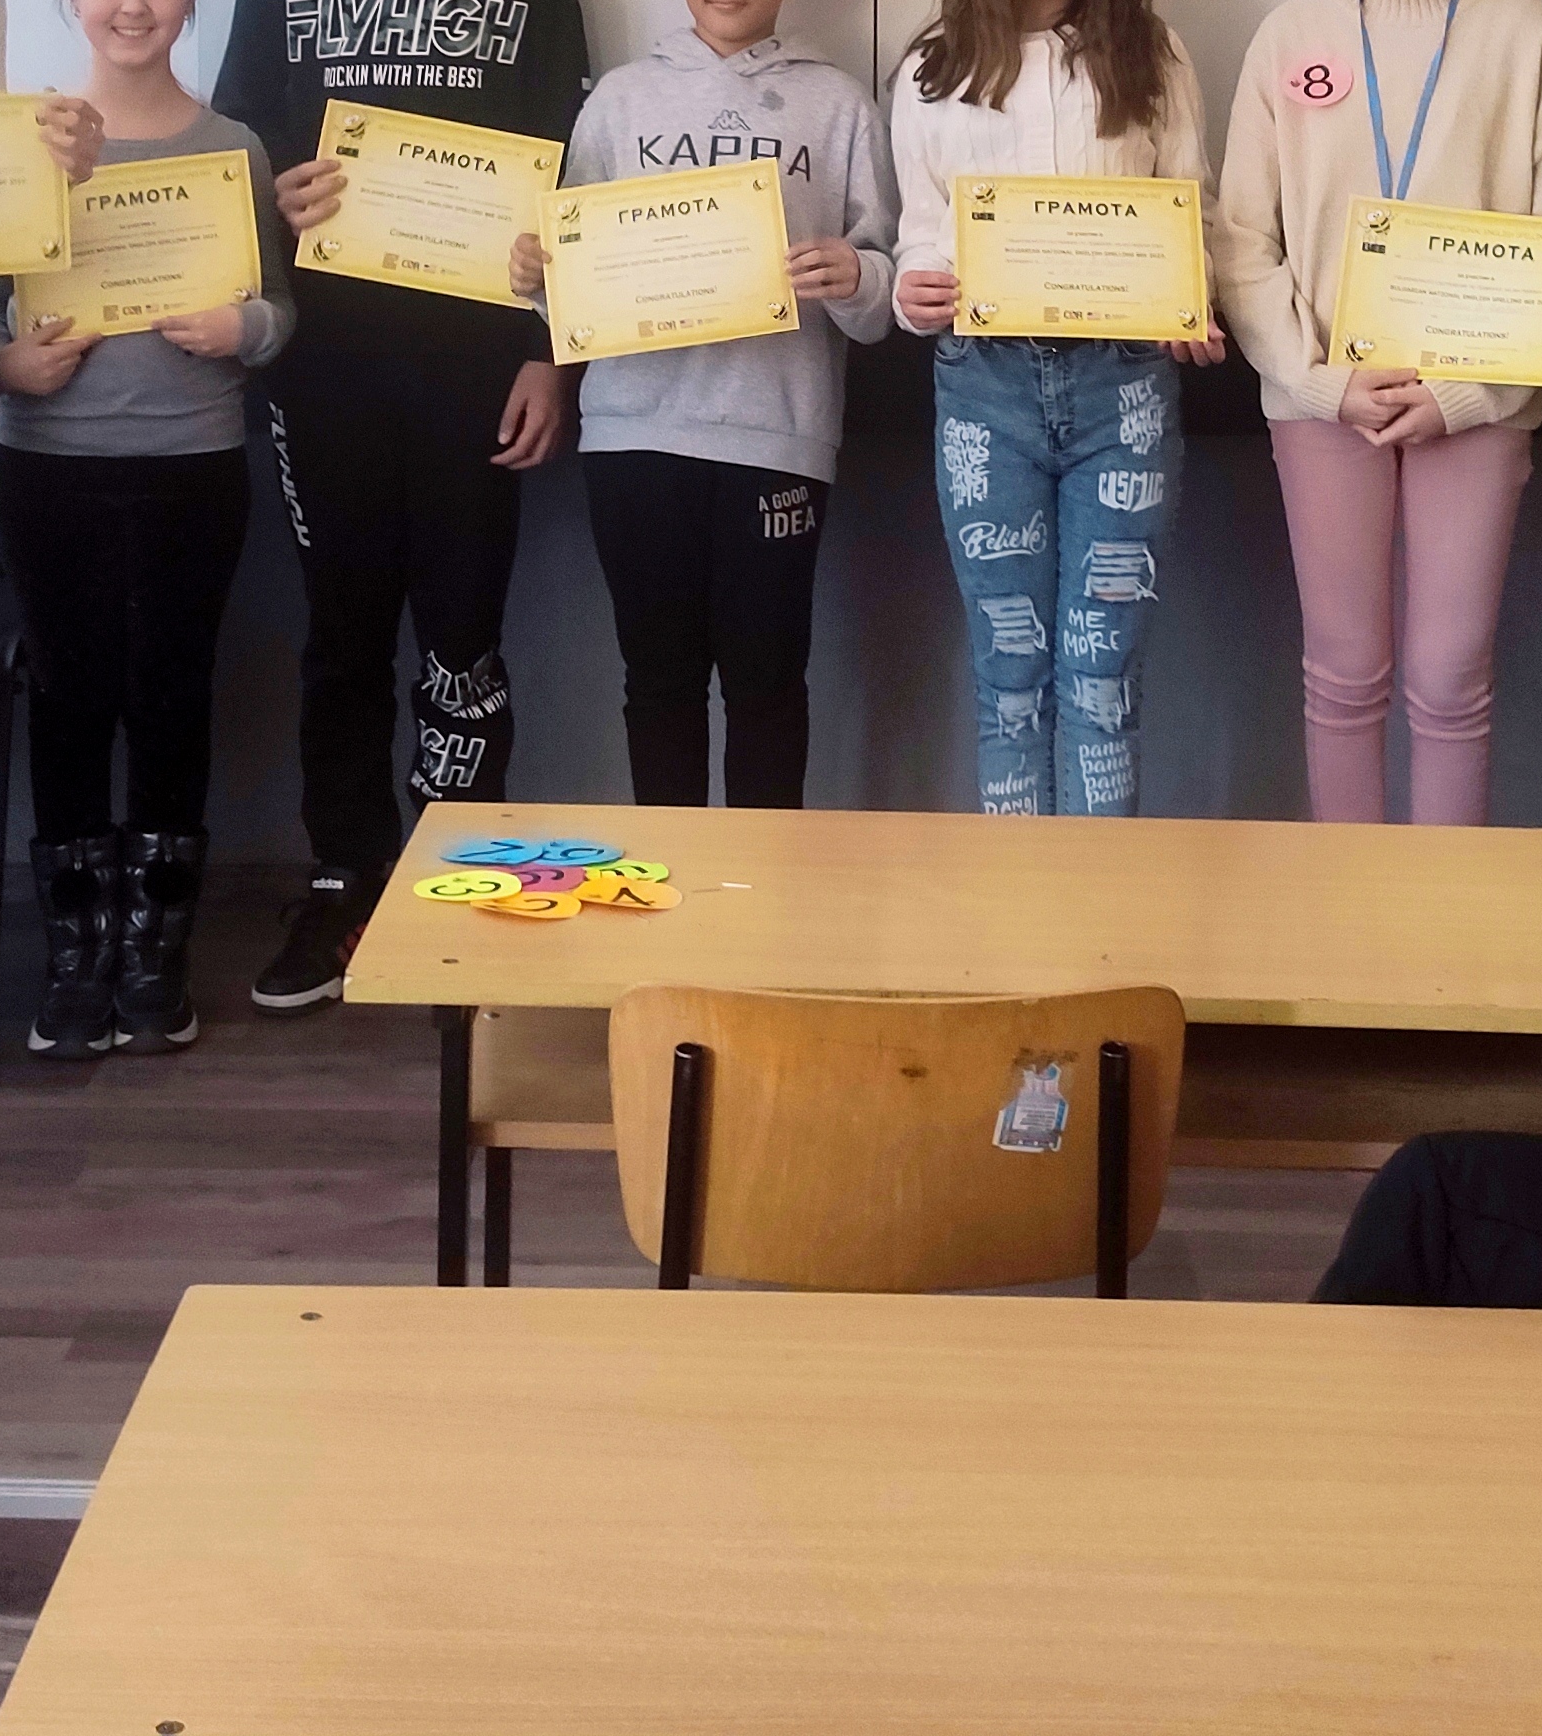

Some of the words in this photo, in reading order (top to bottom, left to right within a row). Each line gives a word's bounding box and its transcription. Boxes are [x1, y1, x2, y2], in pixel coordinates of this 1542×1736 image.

[324, 64, 368, 87] ROCKIN
[372, 65, 411, 86] WITH
[415, 65, 443, 87] THE
[447, 66, 484, 89] BEST
[1303, 64, 1334, 99] 8
[398, 142, 498, 176] ГРАМОТА
[637, 133, 812, 183] KAPPA
[85, 185, 190, 212] ГРАМОТА
[617, 196, 720, 225] ГРАМОТА
[1034, 200, 1139, 217] ГРАМОТА
[1428, 235, 1535, 262] ГРАМОТА
[758, 495, 770, 512] A
[772, 485, 810, 510] GOOD
[764, 505, 816, 539] IDEA
[1068, 607, 1107, 630] ME
[1063, 630, 1122, 664] MORE
